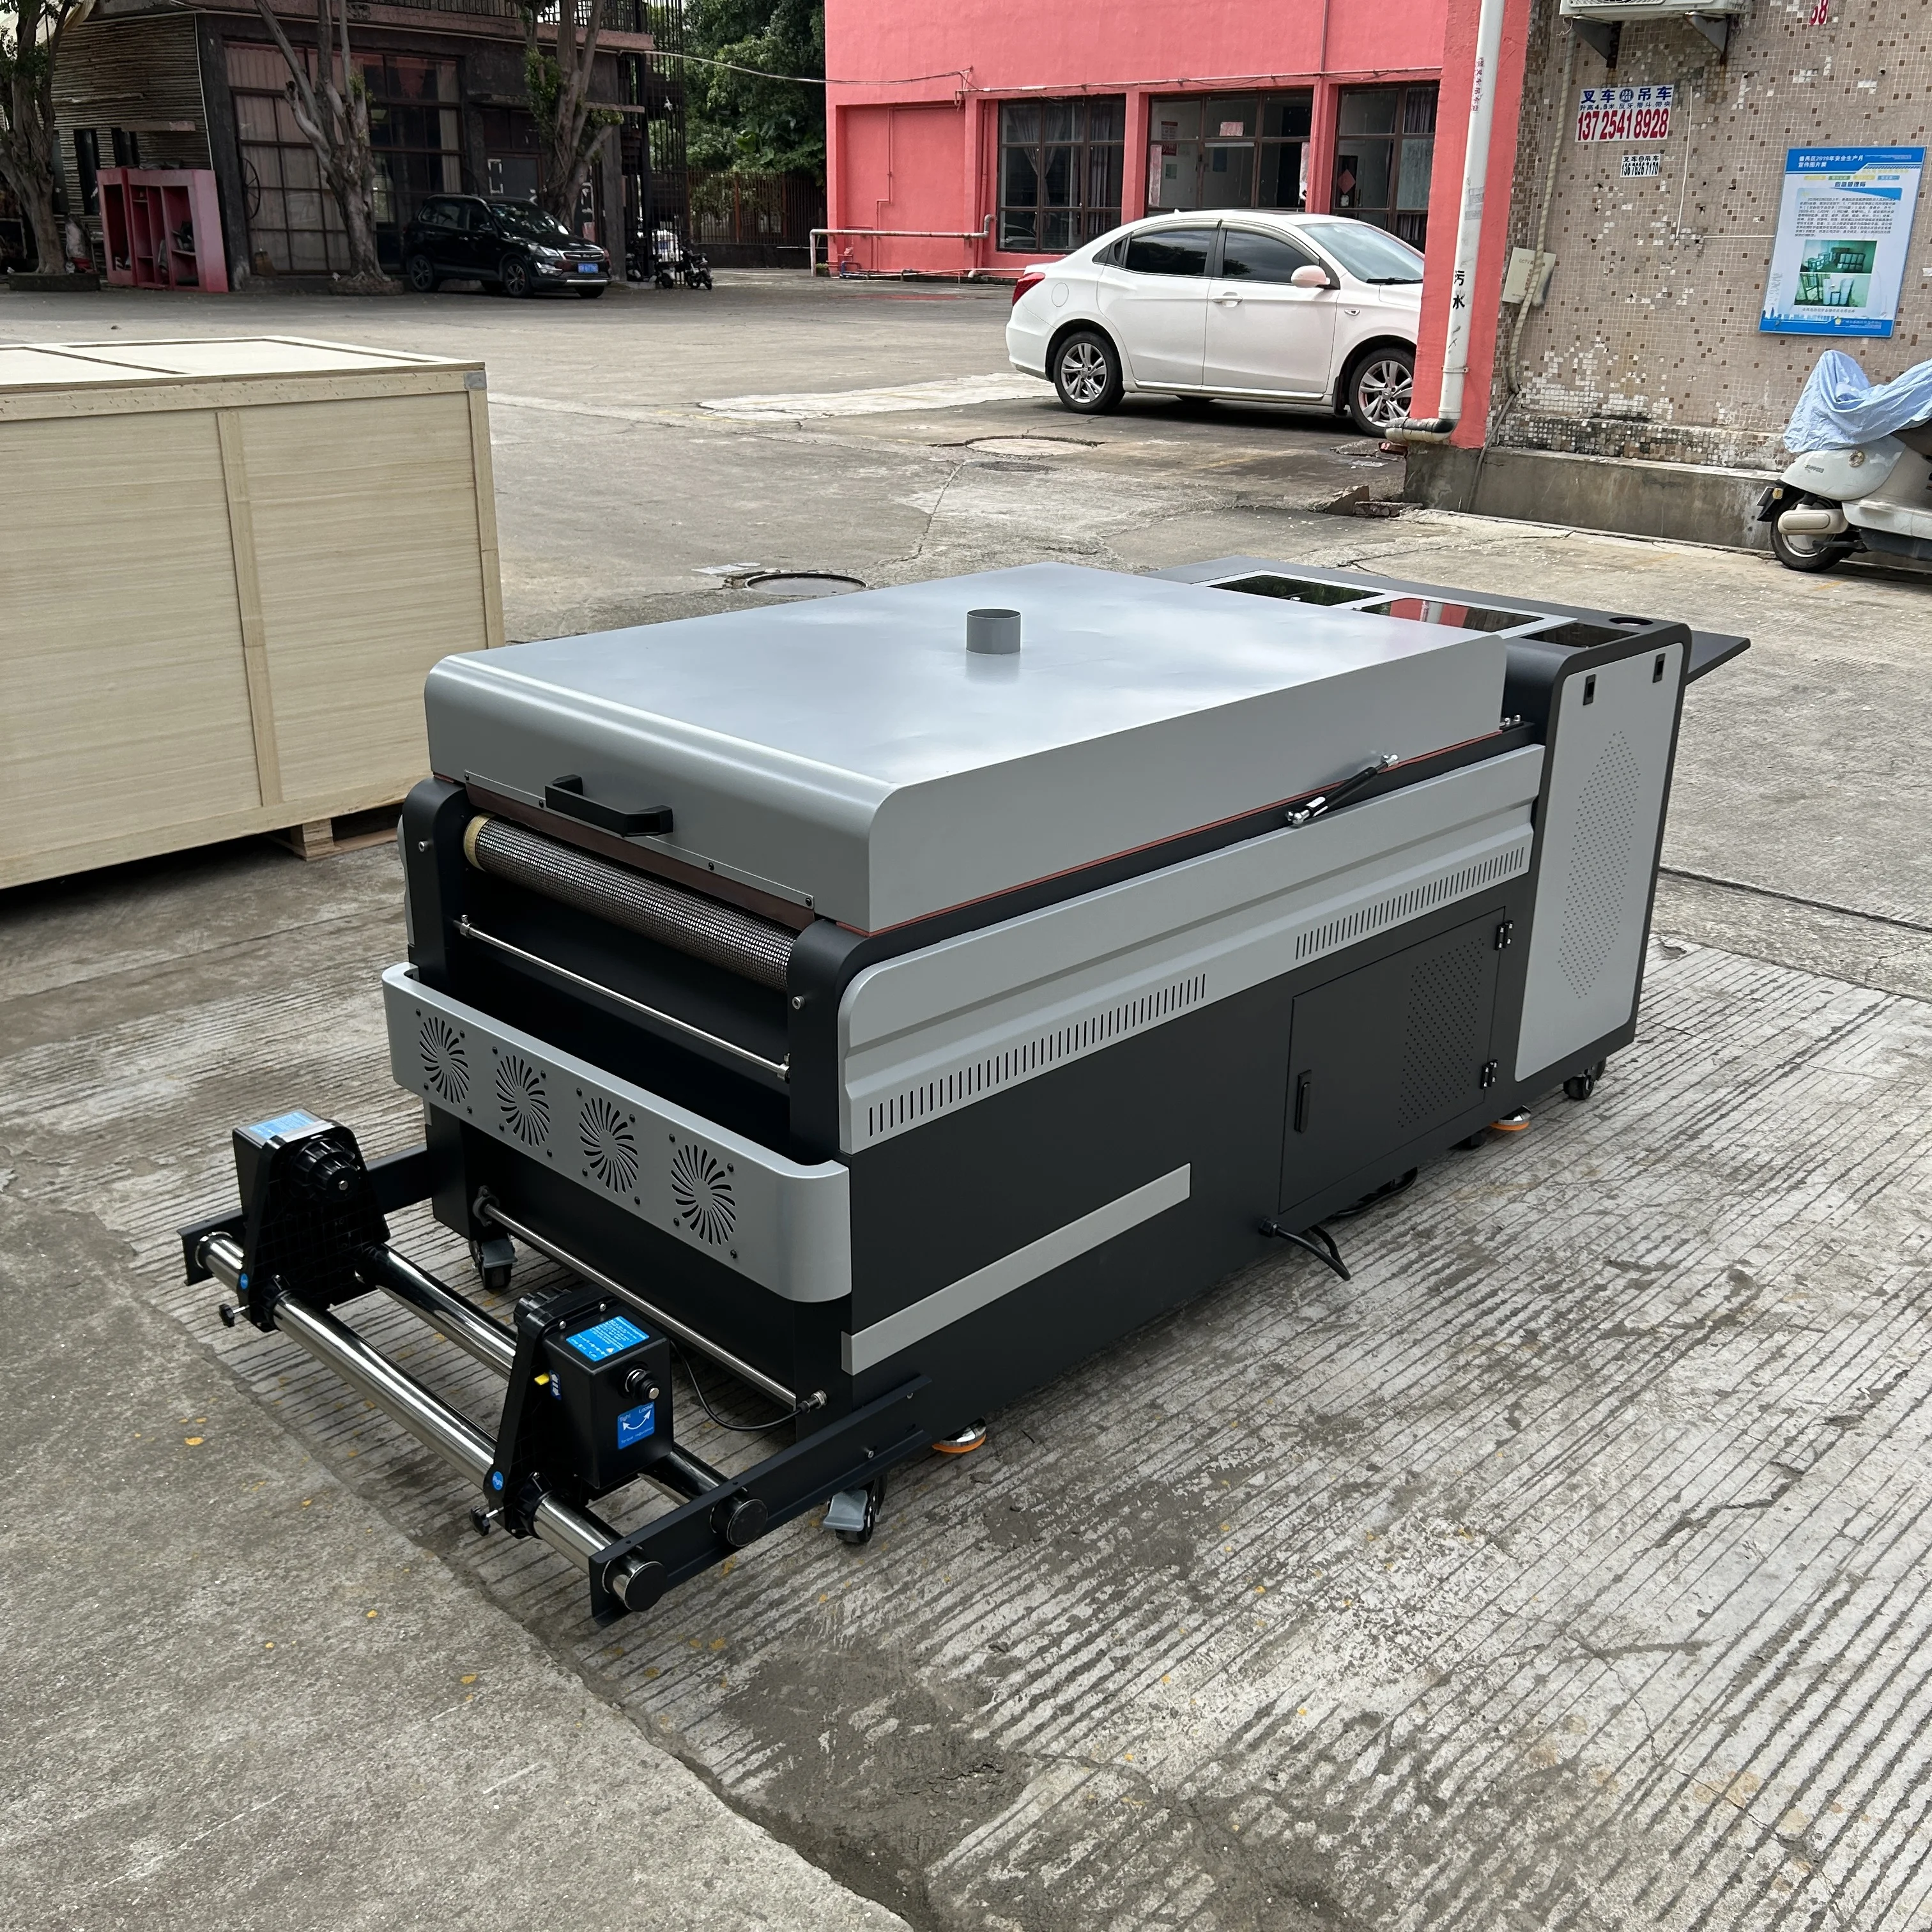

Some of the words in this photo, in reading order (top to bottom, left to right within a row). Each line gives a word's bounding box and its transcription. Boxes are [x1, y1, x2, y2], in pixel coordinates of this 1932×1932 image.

[1581, 89, 1616, 104] 叉车
[1637, 86, 1673, 102] 吊车
[1452, 270, 1465, 310] 污水
